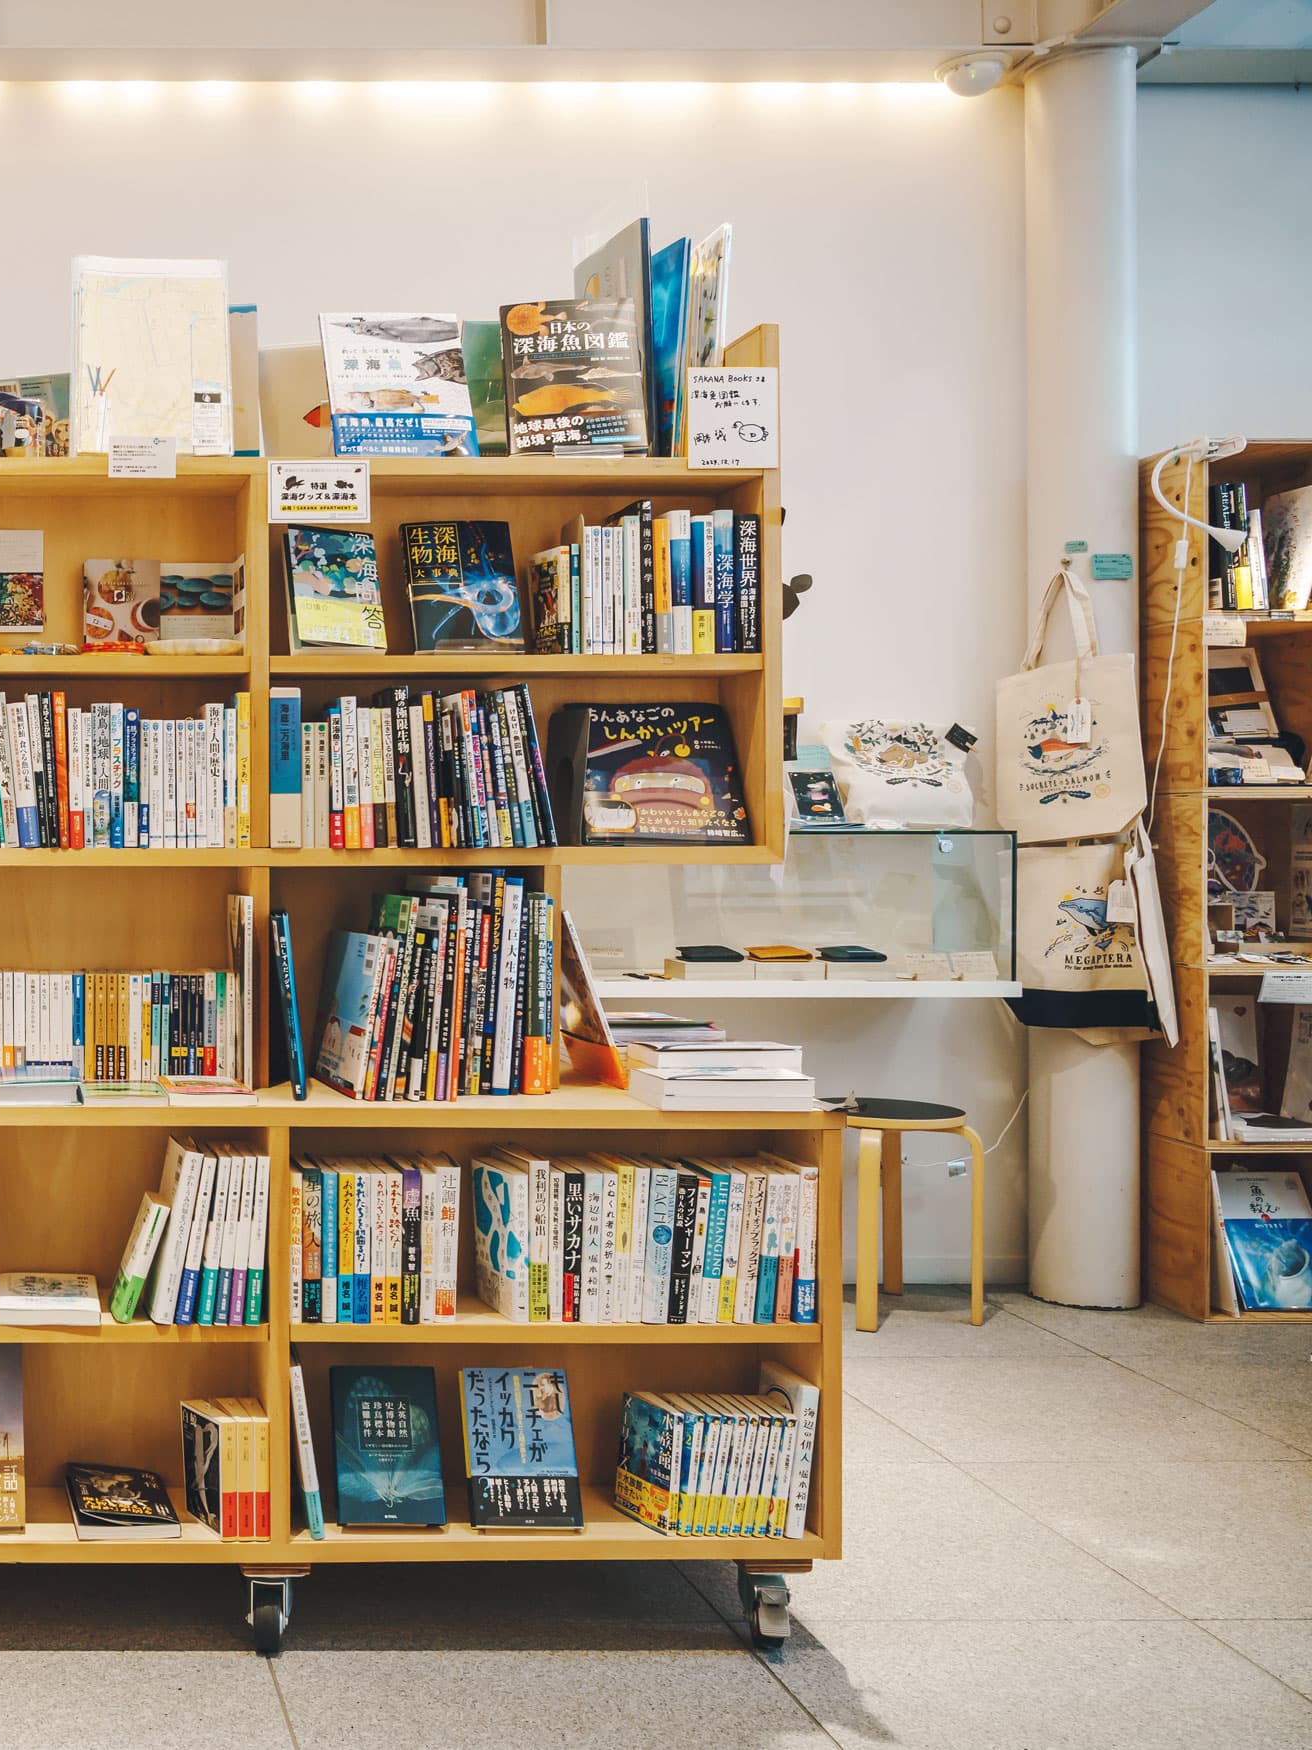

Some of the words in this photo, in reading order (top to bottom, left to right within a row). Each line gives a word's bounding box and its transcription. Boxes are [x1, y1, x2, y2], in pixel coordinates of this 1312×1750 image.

[513, 332, 630, 354] 深海魚図鑑
[550, 322, 590, 334] 日本の
[728, 374, 753, 383] Books
[513, 415, 584, 434] 地球最後の
[515, 430, 588, 448] 秘境・深海。
[310, 482, 327, 490] 特選
[409, 528, 433, 565] 生物
[433, 526, 458, 564] 深海
[739, 520, 757, 587] 深海世界
[414, 567, 458, 578] 大事典
[716, 554, 734, 607] 深海学
[394, 688, 409, 754] 海の極限生物
[603, 716, 715, 740] しんかいツアー
[97, 706, 109, 790] 海鳥と地球と人間
[112, 738, 121, 789] プラスチック
[1064, 773, 1102, 787] SALMON
[504, 893, 519, 990] 世界の巨大生物
[1064, 953, 1132, 964] MEGAPTERA
[441, 1174, 457, 1238] 辻調鮨科
[719, 1181, 728, 1205] LIFE
[306, 1176, 321, 1248] 星の旅人
[565, 1183, 582, 1271] 黒いサカナ
[604, 1179, 616, 1270] ひねくれ者の分析力
[681, 1188, 695, 1268] フィッシャーマン
[711, 1207, 726, 1275] CHANGING
[361, 1402, 372, 1438] 盗難事件
[373, 1402, 384, 1438] 珍鳥標本
[385, 1402, 396, 1438] 史博物館
[397, 1402, 408, 1438] 大英自然
[495, 1371, 515, 1449] イッカク
[523, 1372, 548, 1463] ニーチェが
[467, 1370, 490, 1499] だったなら？
